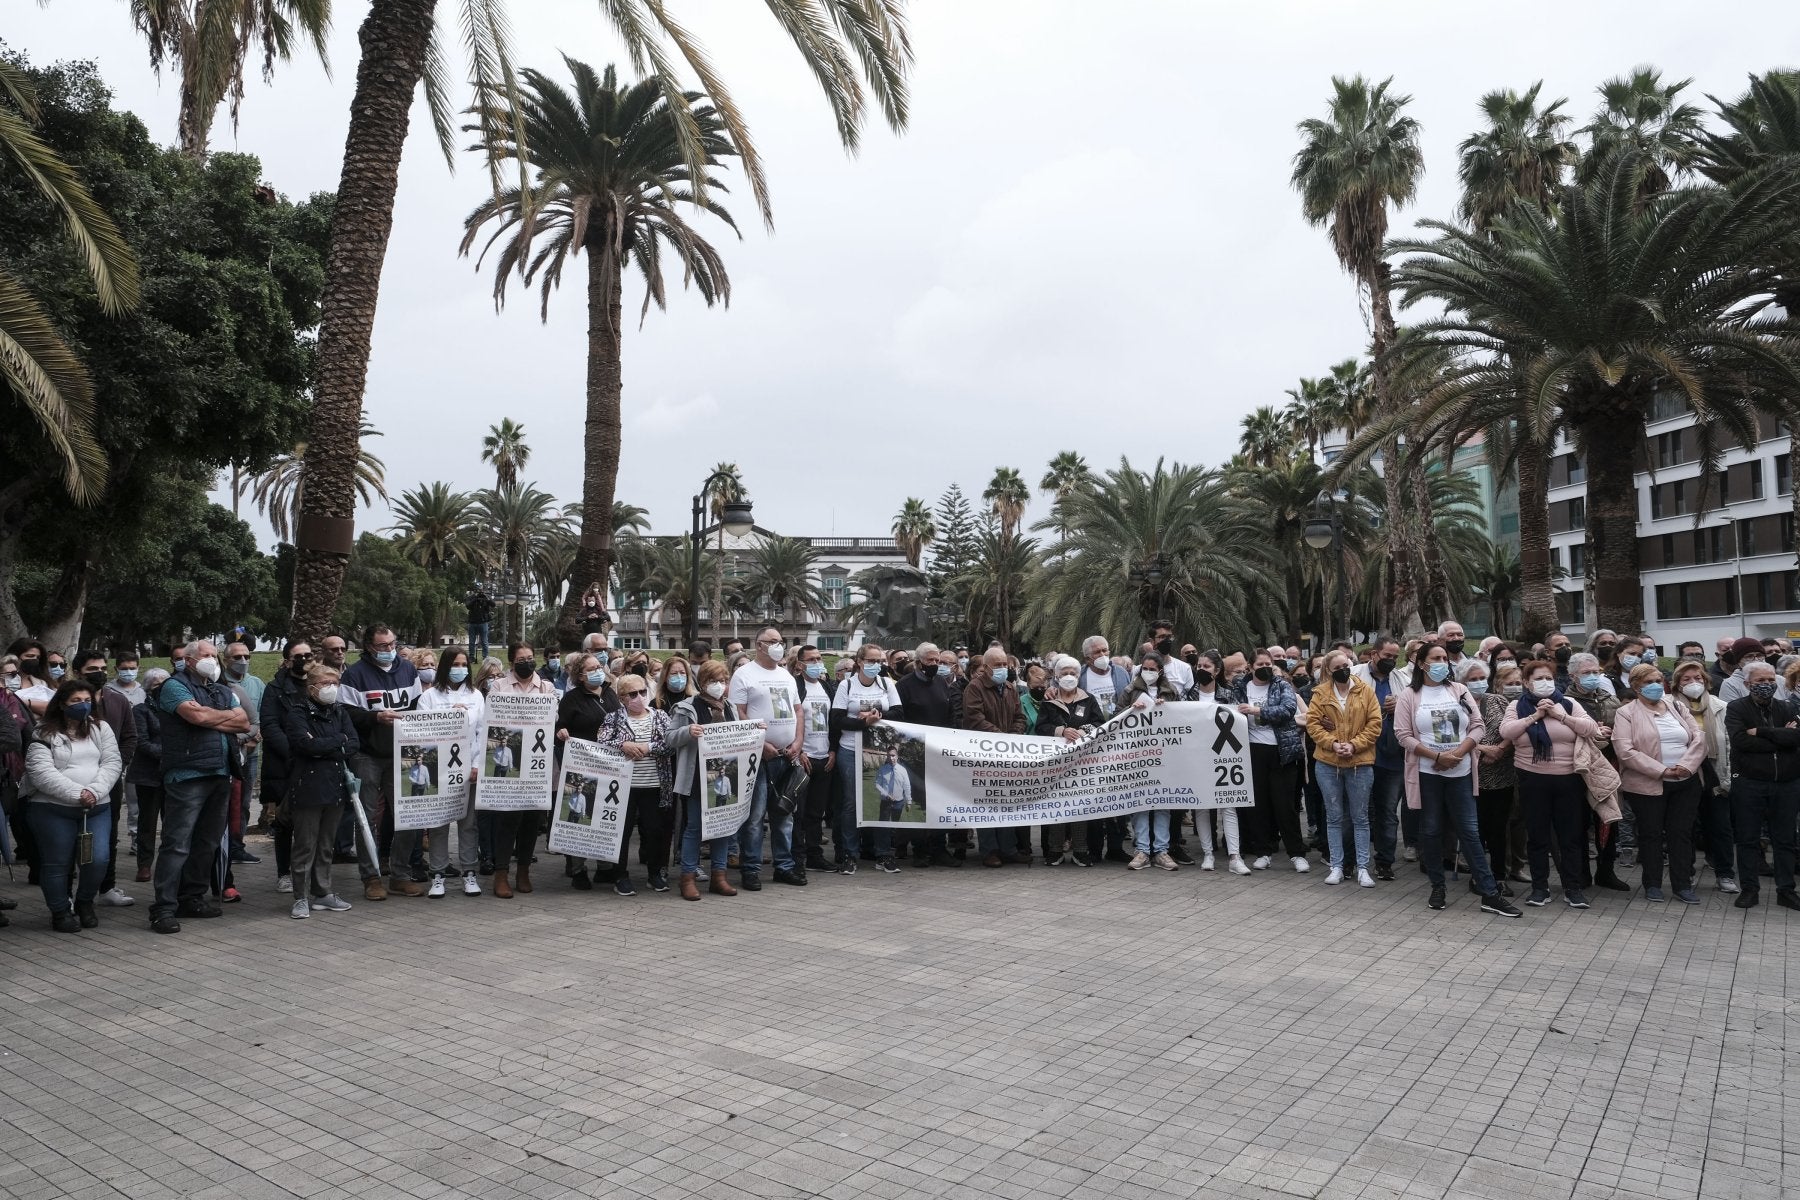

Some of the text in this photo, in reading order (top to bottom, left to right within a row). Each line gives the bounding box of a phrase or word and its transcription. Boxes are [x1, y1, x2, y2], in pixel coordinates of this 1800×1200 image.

[366, 690, 409, 710] FILA
[942, 749, 1002, 758] REACTIVEN
[1121, 726, 1192, 740] TRIPULANTES
[531, 759, 545, 769] 26
[952, 738, 1182, 769] DESAPARECIDOS EN EL VILLA PINTANXO ¡YA!
[1074, 749, 1163, 766] WWW.CHANGE.ORG
[448, 774, 464, 785] 26
[990, 778, 1041, 786] MEMORIA
[1044, 776, 1057, 784] DE
[1059, 769, 1078, 779] LOS
[1081, 758, 1162, 776] DESPARECIDOS
[1214, 765, 1244, 787] 26
[1010, 786, 1047, 796] BARCO
[1050, 780, 1078, 790] VILLA
[1081, 778, 1095, 787] DE
[1099, 771, 1149, 785] PINTANXO
[1026, 792, 1057, 803] MANOLO
[1058, 788, 1094, 798] NAVARRO
[1110, 784, 1128, 793] GRAN
[1130, 779, 1161, 789] CANARIA
[946, 804, 985, 813] SÁBADO
[1016, 801, 1061, 812] FEBRERO
[1073, 795, 1091, 807] LAS
[1094, 794, 1117, 804] 12:00
[1119, 791, 1132, 801] AM
[1134, 789, 1145, 798] EN
[1148, 788, 1160, 796] LA
[602, 810, 617, 821] 26
[999, 813, 1040, 823] (FRENTE
[1050, 810, 1062, 818] LA
[1064, 802, 1125, 817] DELEGACIÓN
[1126, 801, 1143, 810] DEL
